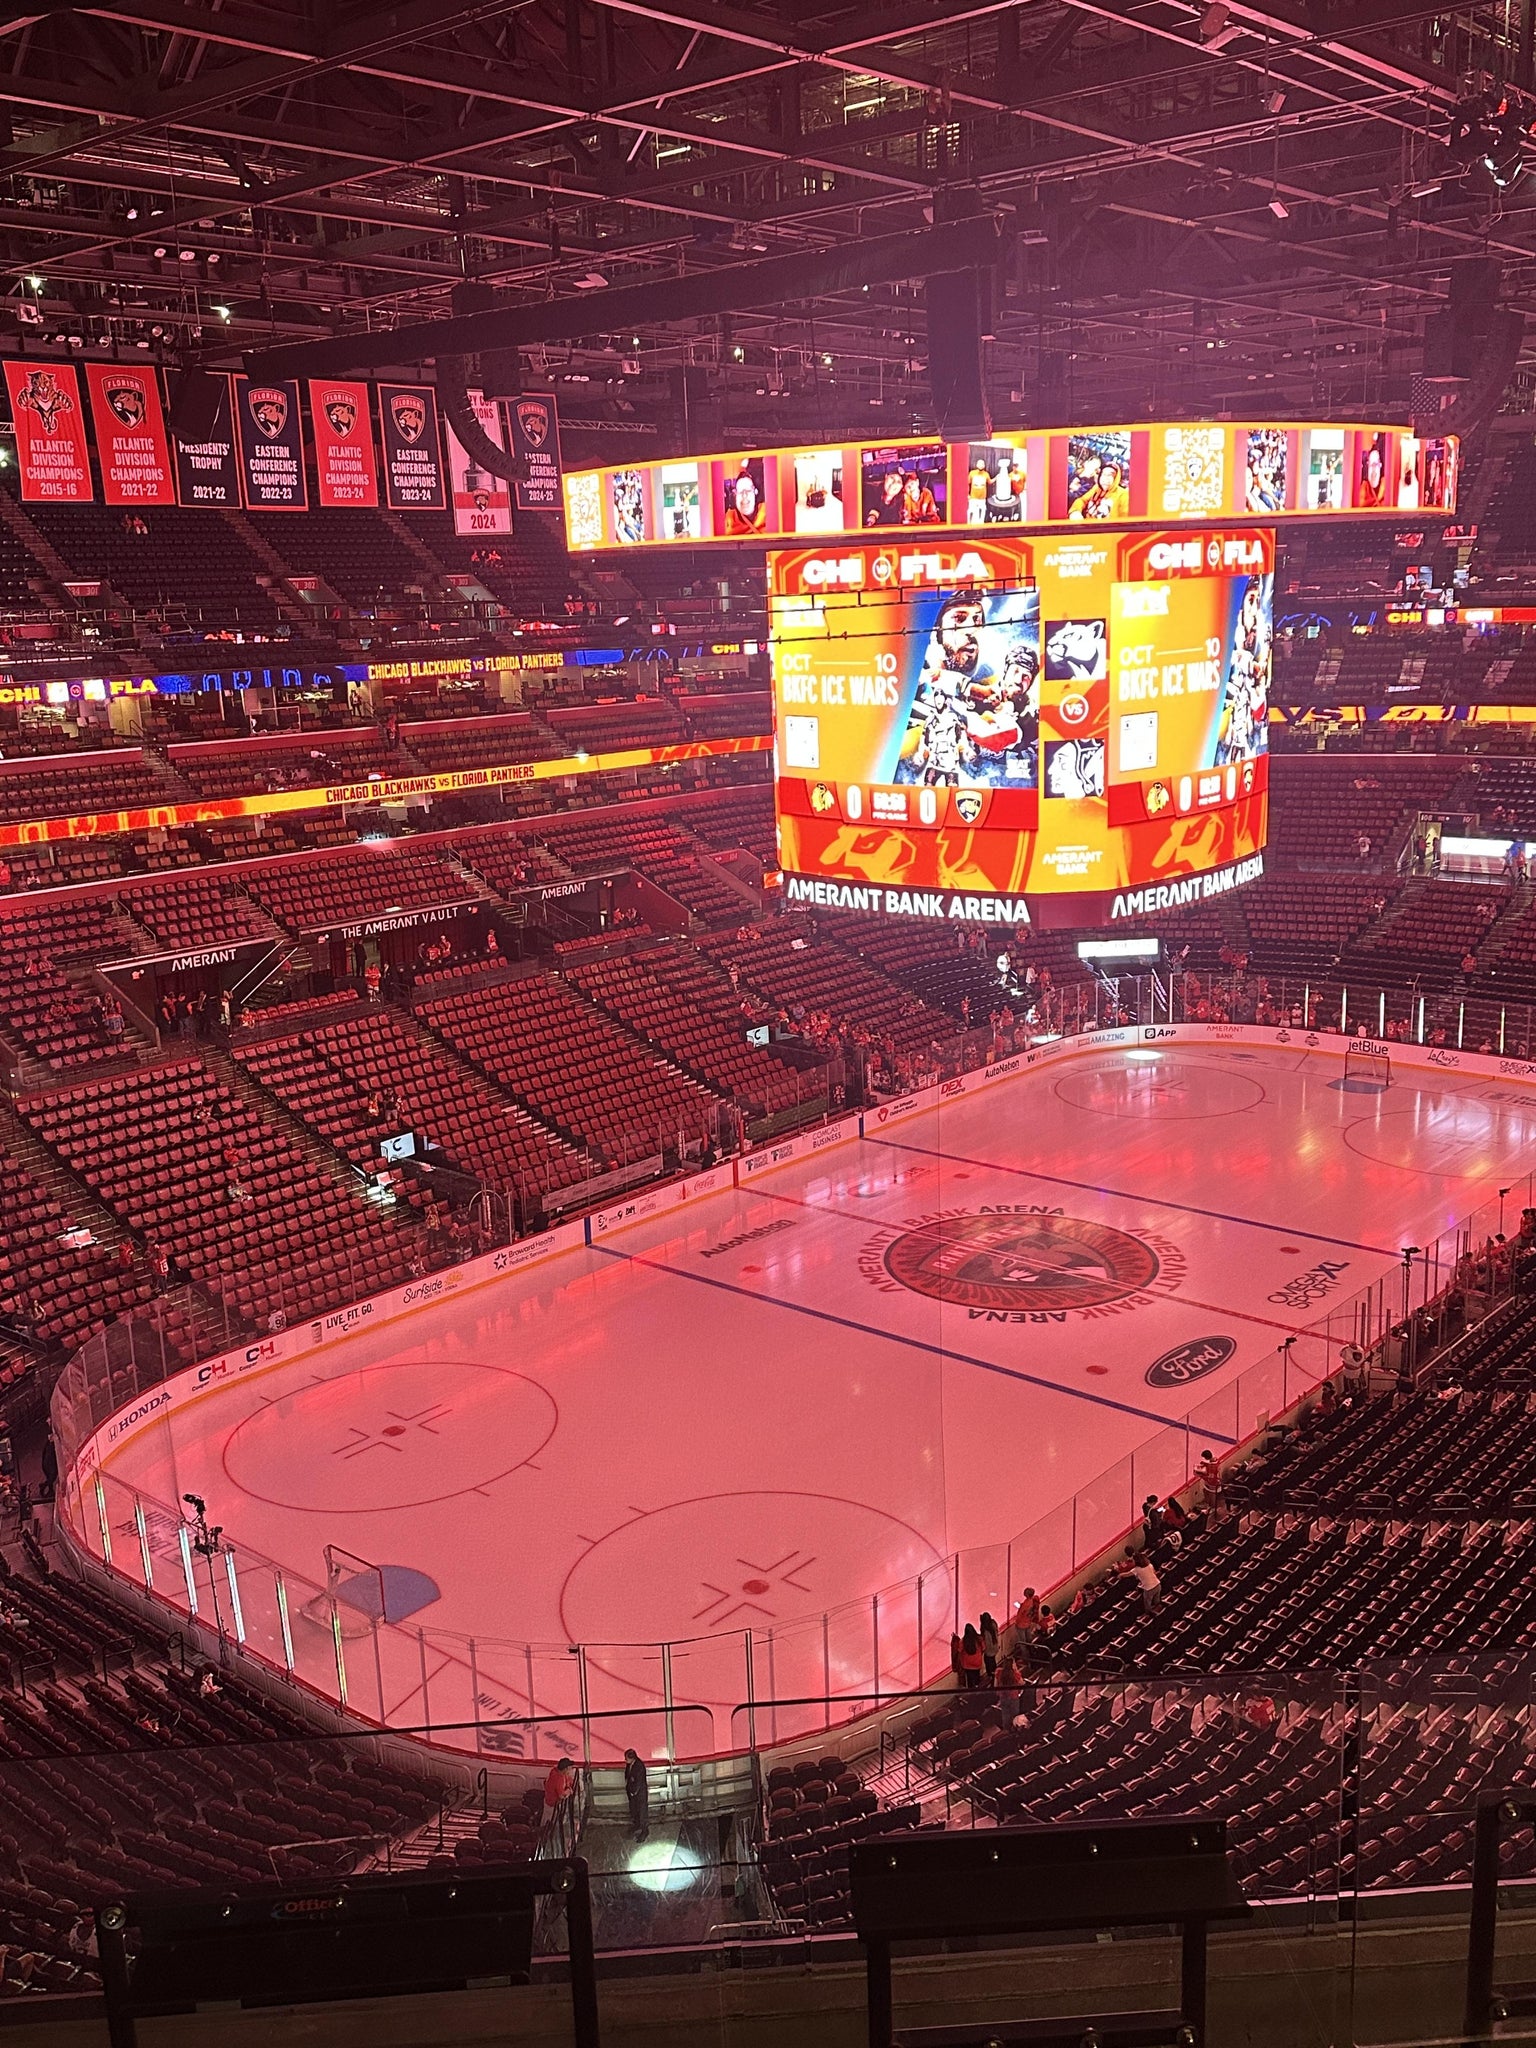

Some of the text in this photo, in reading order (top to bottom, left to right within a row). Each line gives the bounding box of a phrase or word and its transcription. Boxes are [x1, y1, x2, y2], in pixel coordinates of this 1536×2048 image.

[107, 380, 141, 391] FLORIDA
[326, 394, 353, 403] FLORIDA
[30, 440, 75, 453] ATLANTIC
[112, 437, 155, 451] ATLANTIC
[179, 440, 230, 456] PRESIDENTS'
[255, 445, 290, 458] EASTERN
[32, 453, 75, 466] DIVISION
[115, 453, 156, 466] DIVISION
[328, 446, 362, 458] ATLANTIC
[397, 449, 428, 461] EASTERN
[190, 456, 222, 470] TROPHY
[249, 459, 298, 472] CONFERENCE
[330, 460, 362, 472] DIVISION
[391, 462, 436, 475] CONFERENCE
[26, 467, 84, 480] CHAMPIONS
[110, 468, 164, 481] CHAMPIONS
[252, 473, 298, 486] CHAMPIONS
[326, 473, 369, 485] CHAMPIONS
[40, 483, 77, 496] 2015-16
[121, 483, 158, 496] 2021-22
[394, 476, 436, 488] CHAMPIONS
[192, 486, 226, 499] 2021-22
[261, 487, 292, 499] 2022-23
[333, 487, 364, 499] 2023-24
[401, 489, 431, 500] 2023-24
[529, 491, 554, 501] 2024-25
[470, 514, 496, 529] 2024
[1044, 552, 1108, 566] AMERANT
[1149, 542, 1202, 570] CHI
[1224, 540, 1264, 566] FLA
[803, 557, 862, 585] CHI
[900, 552, 989, 581] FLA
[1058, 564, 1093, 578] BANK
[1387, 612, 1422, 624] CHI
[711, 643, 739, 655] CHI
[1120, 637, 1220, 666] OCT 10
[367, 662, 409, 680] CHICAGO
[411, 658, 472, 677] BLACKHAWKS
[485, 655, 520, 672] FLORIDA
[521, 652, 564, 670] PANTHERS
[782, 653, 897, 672] OCT 10
[1119, 660, 1221, 702] BKFC ICE WARS
[0, 686, 40, 703] CHI
[110, 679, 158, 695] FLA
[782, 676, 899, 706] BKFC ICE WARS
[1064, 703, 1084, 715] VS
[326, 786, 368, 803] CHICAGO
[372, 777, 436, 797] BLACKHAWKS
[451, 771, 489, 787] FLORIDA
[491, 766, 535, 782] PANTHERS
[1179, 776, 1193, 812] 0
[1226, 766, 1237, 800] 0
[847, 785, 862, 819] 0
[919, 789, 936, 824] 0
[1042, 850, 1103, 865] AMERANT
[1056, 863, 1089, 875] BANK
[541, 882, 587, 900] AMERANT
[1111, 854, 1264, 919] AMERANT BANK ARENA
[787, 877, 1031, 923] AMERANT BANK ARENA
[341, 907, 458, 940] THE AMERANT VAULT
[171, 948, 237, 972] AMERANT
[1206, 1025, 1244, 1033] AMERANT
[1090, 1032, 1125, 1045] AMAZING
[1348, 1039, 1389, 1055] jetBlue
[984, 1059, 1020, 1079] AutoNation
[1500, 1061, 1527, 1070] OMEGA
[1500, 1066, 1526, 1075] SPORT
[941, 1078, 963, 1095] DEX
[812, 1124, 841, 1140] COMCAST
[813, 1132, 841, 1148] BUSINESS
[694, 1175, 716, 1191] Coca-Cola
[700, 1219, 793, 1258] AutoNation
[508, 1235, 556, 1259] Broward Health
[857, 1204, 1065, 1293] AMERANT BANK ARENA
[932, 1225, 1022, 1271] PANTHERS
[969, 1228, 1188, 1324] AMERANT BANK ARENA
[1267, 1260, 1350, 1304] OMEGA XL
[403, 1278, 443, 1303] Surfside
[1286, 1278, 1343, 1310] SPORT
[326, 1312, 345, 1329] LIVE.
[362, 1303, 375, 1316] GO.
[245, 1341, 274, 1364] CH
[239, 1362, 258, 1372] Cooper
[1161, 1344, 1224, 1380] Ford
[198, 1360, 227, 1383] CH
[191, 1381, 211, 1392] Cooper
[118, 1392, 172, 1433] HONDA
